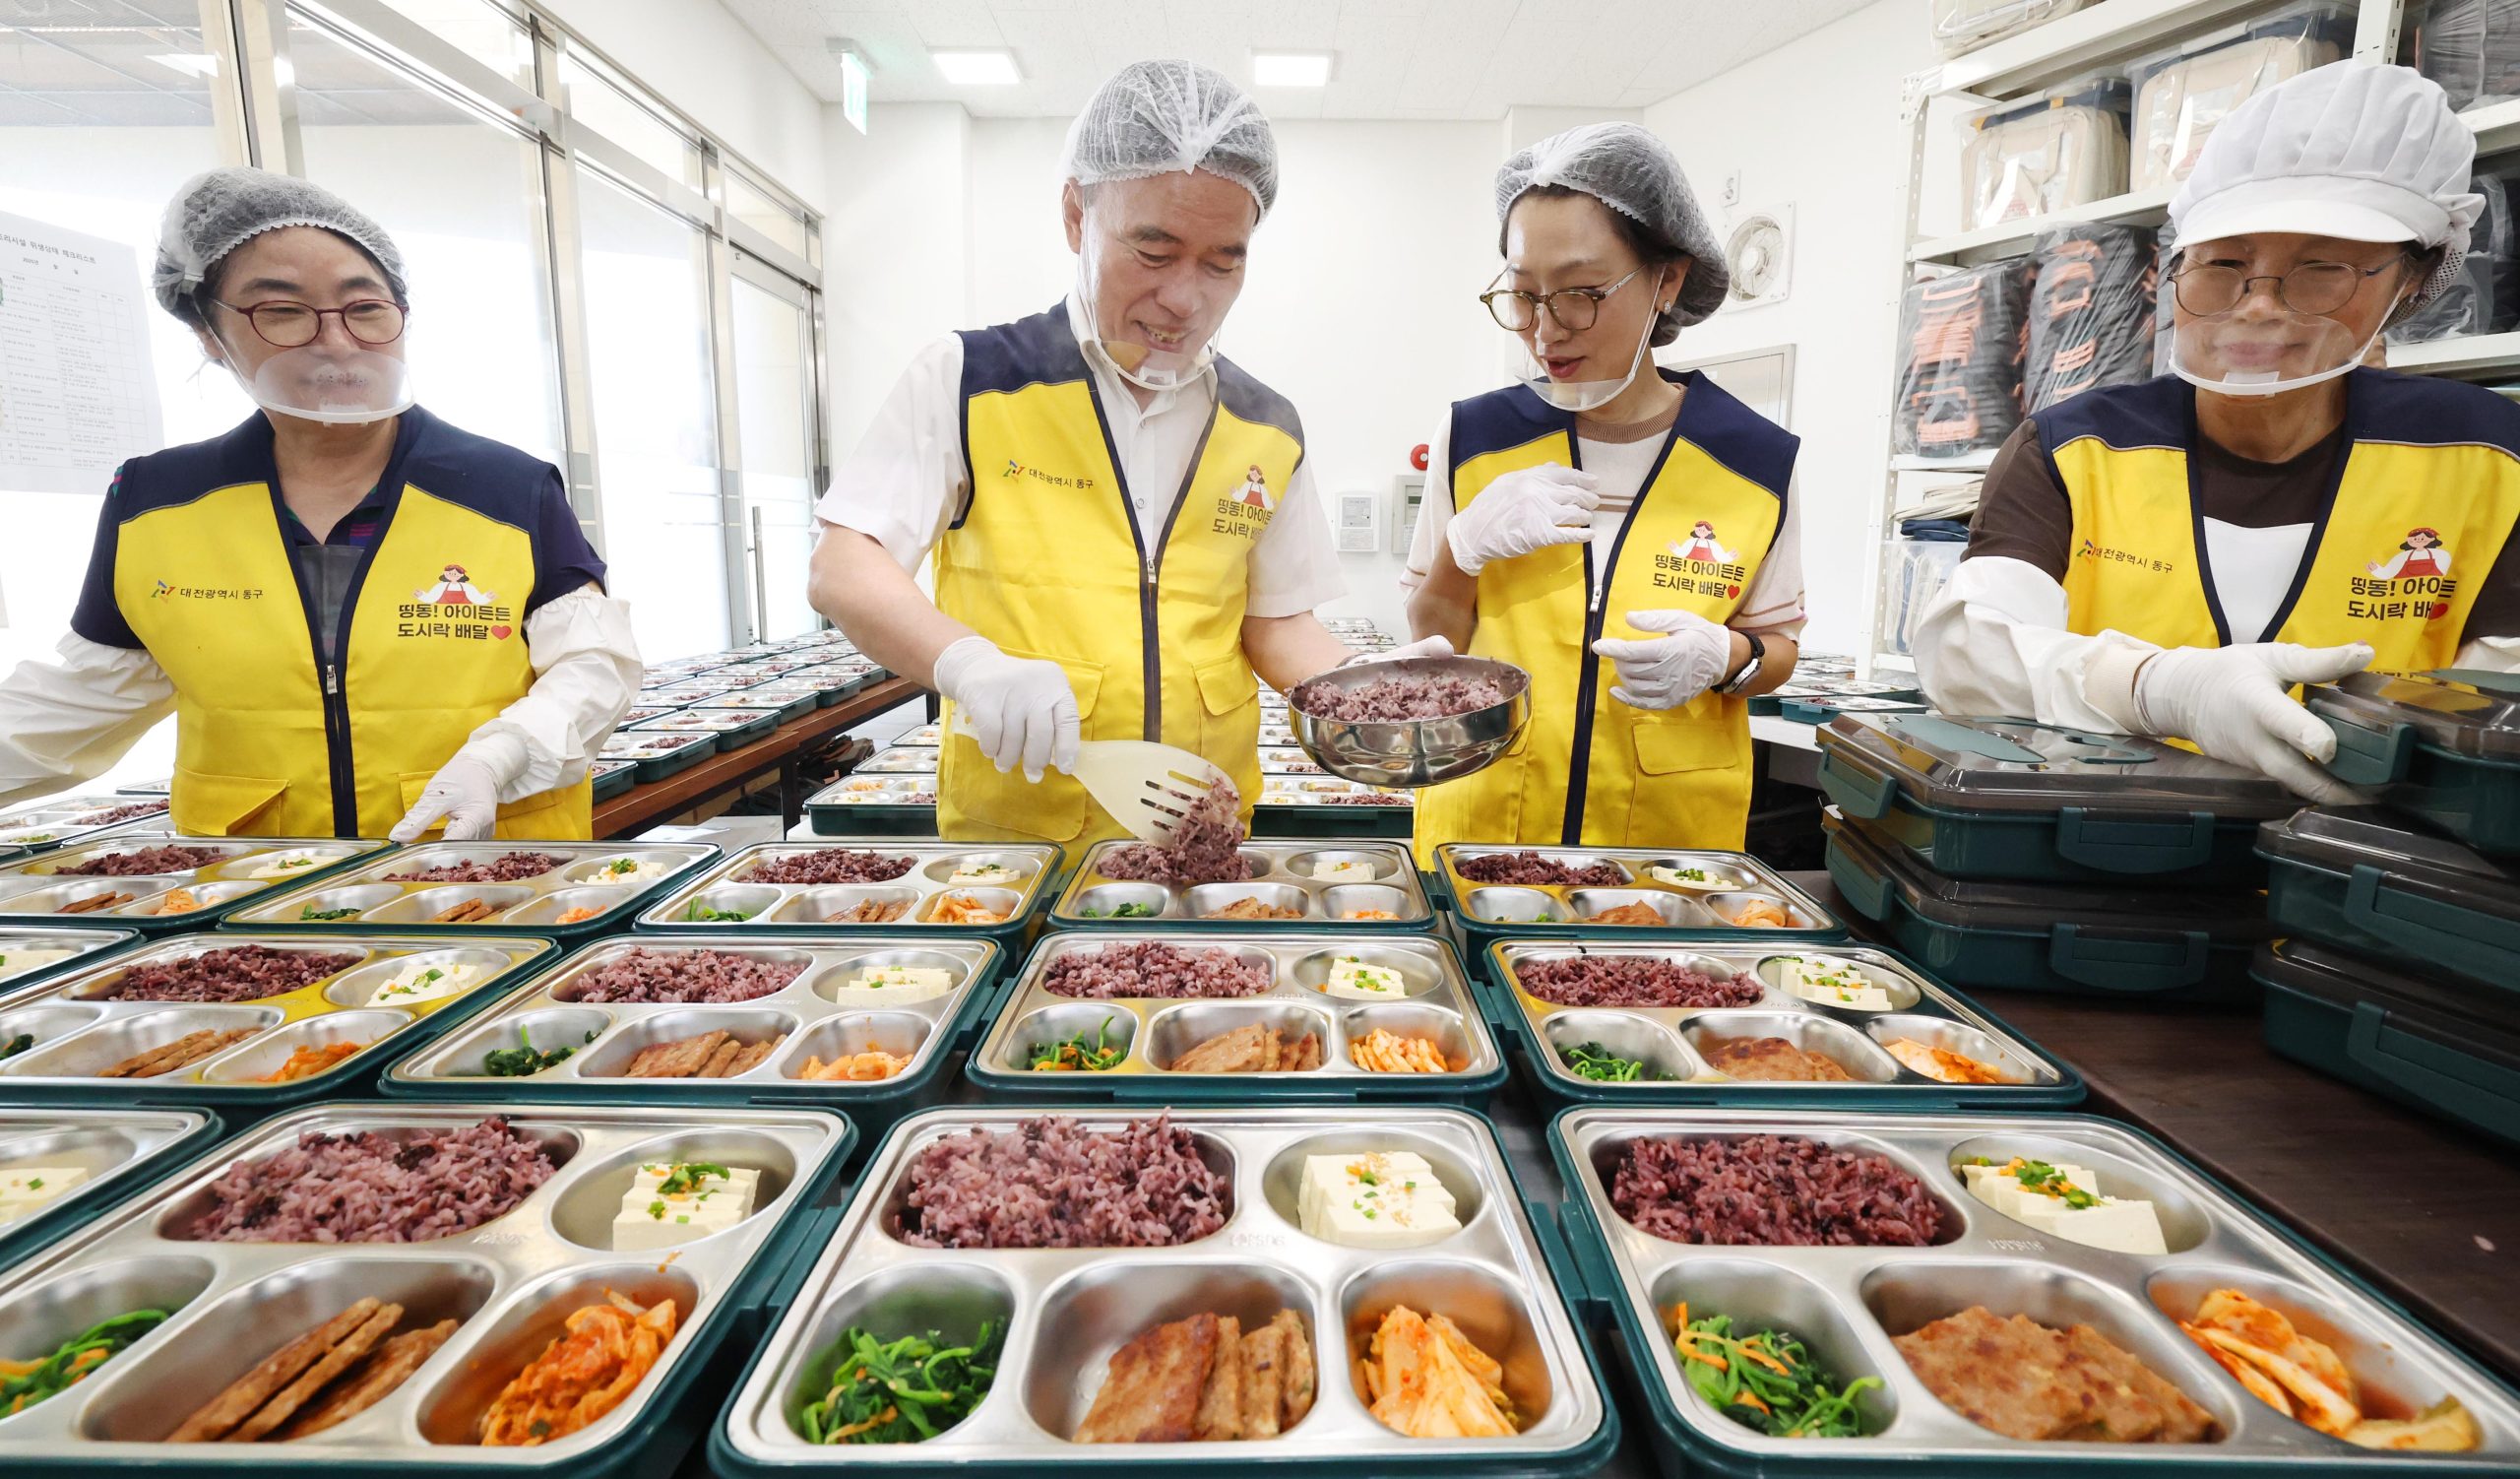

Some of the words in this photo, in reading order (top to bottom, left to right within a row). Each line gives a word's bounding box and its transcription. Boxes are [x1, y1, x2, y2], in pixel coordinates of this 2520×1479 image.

[1029, 468, 1072, 487] 대전광역시
[1076, 479, 1094, 488] 동구
[1217, 498, 1244, 518] 띵동!
[1246, 506, 1274, 525] 아이든
[1213, 518, 1250, 539] 도시락
[1655, 553, 1687, 573] 띵동!
[1691, 561, 1745, 582] 아이든든
[2096, 547, 2148, 568] 대전광역시
[2152, 560, 2174, 573] 동구
[180, 588, 238, 600] 대전광역시
[242, 589, 264, 600] 동구
[1653, 573, 1695, 594] 도시락
[1699, 581, 1727, 599] 배달
[2351, 576, 2396, 597] 띵동!
[399, 604, 437, 618] 띵동!
[444, 605, 510, 621] 아이든든
[2347, 601, 2408, 620] 도시락
[2414, 601, 2434, 618] 배
[398, 622, 451, 638] 도시락
[455, 624, 488, 640] 배달
